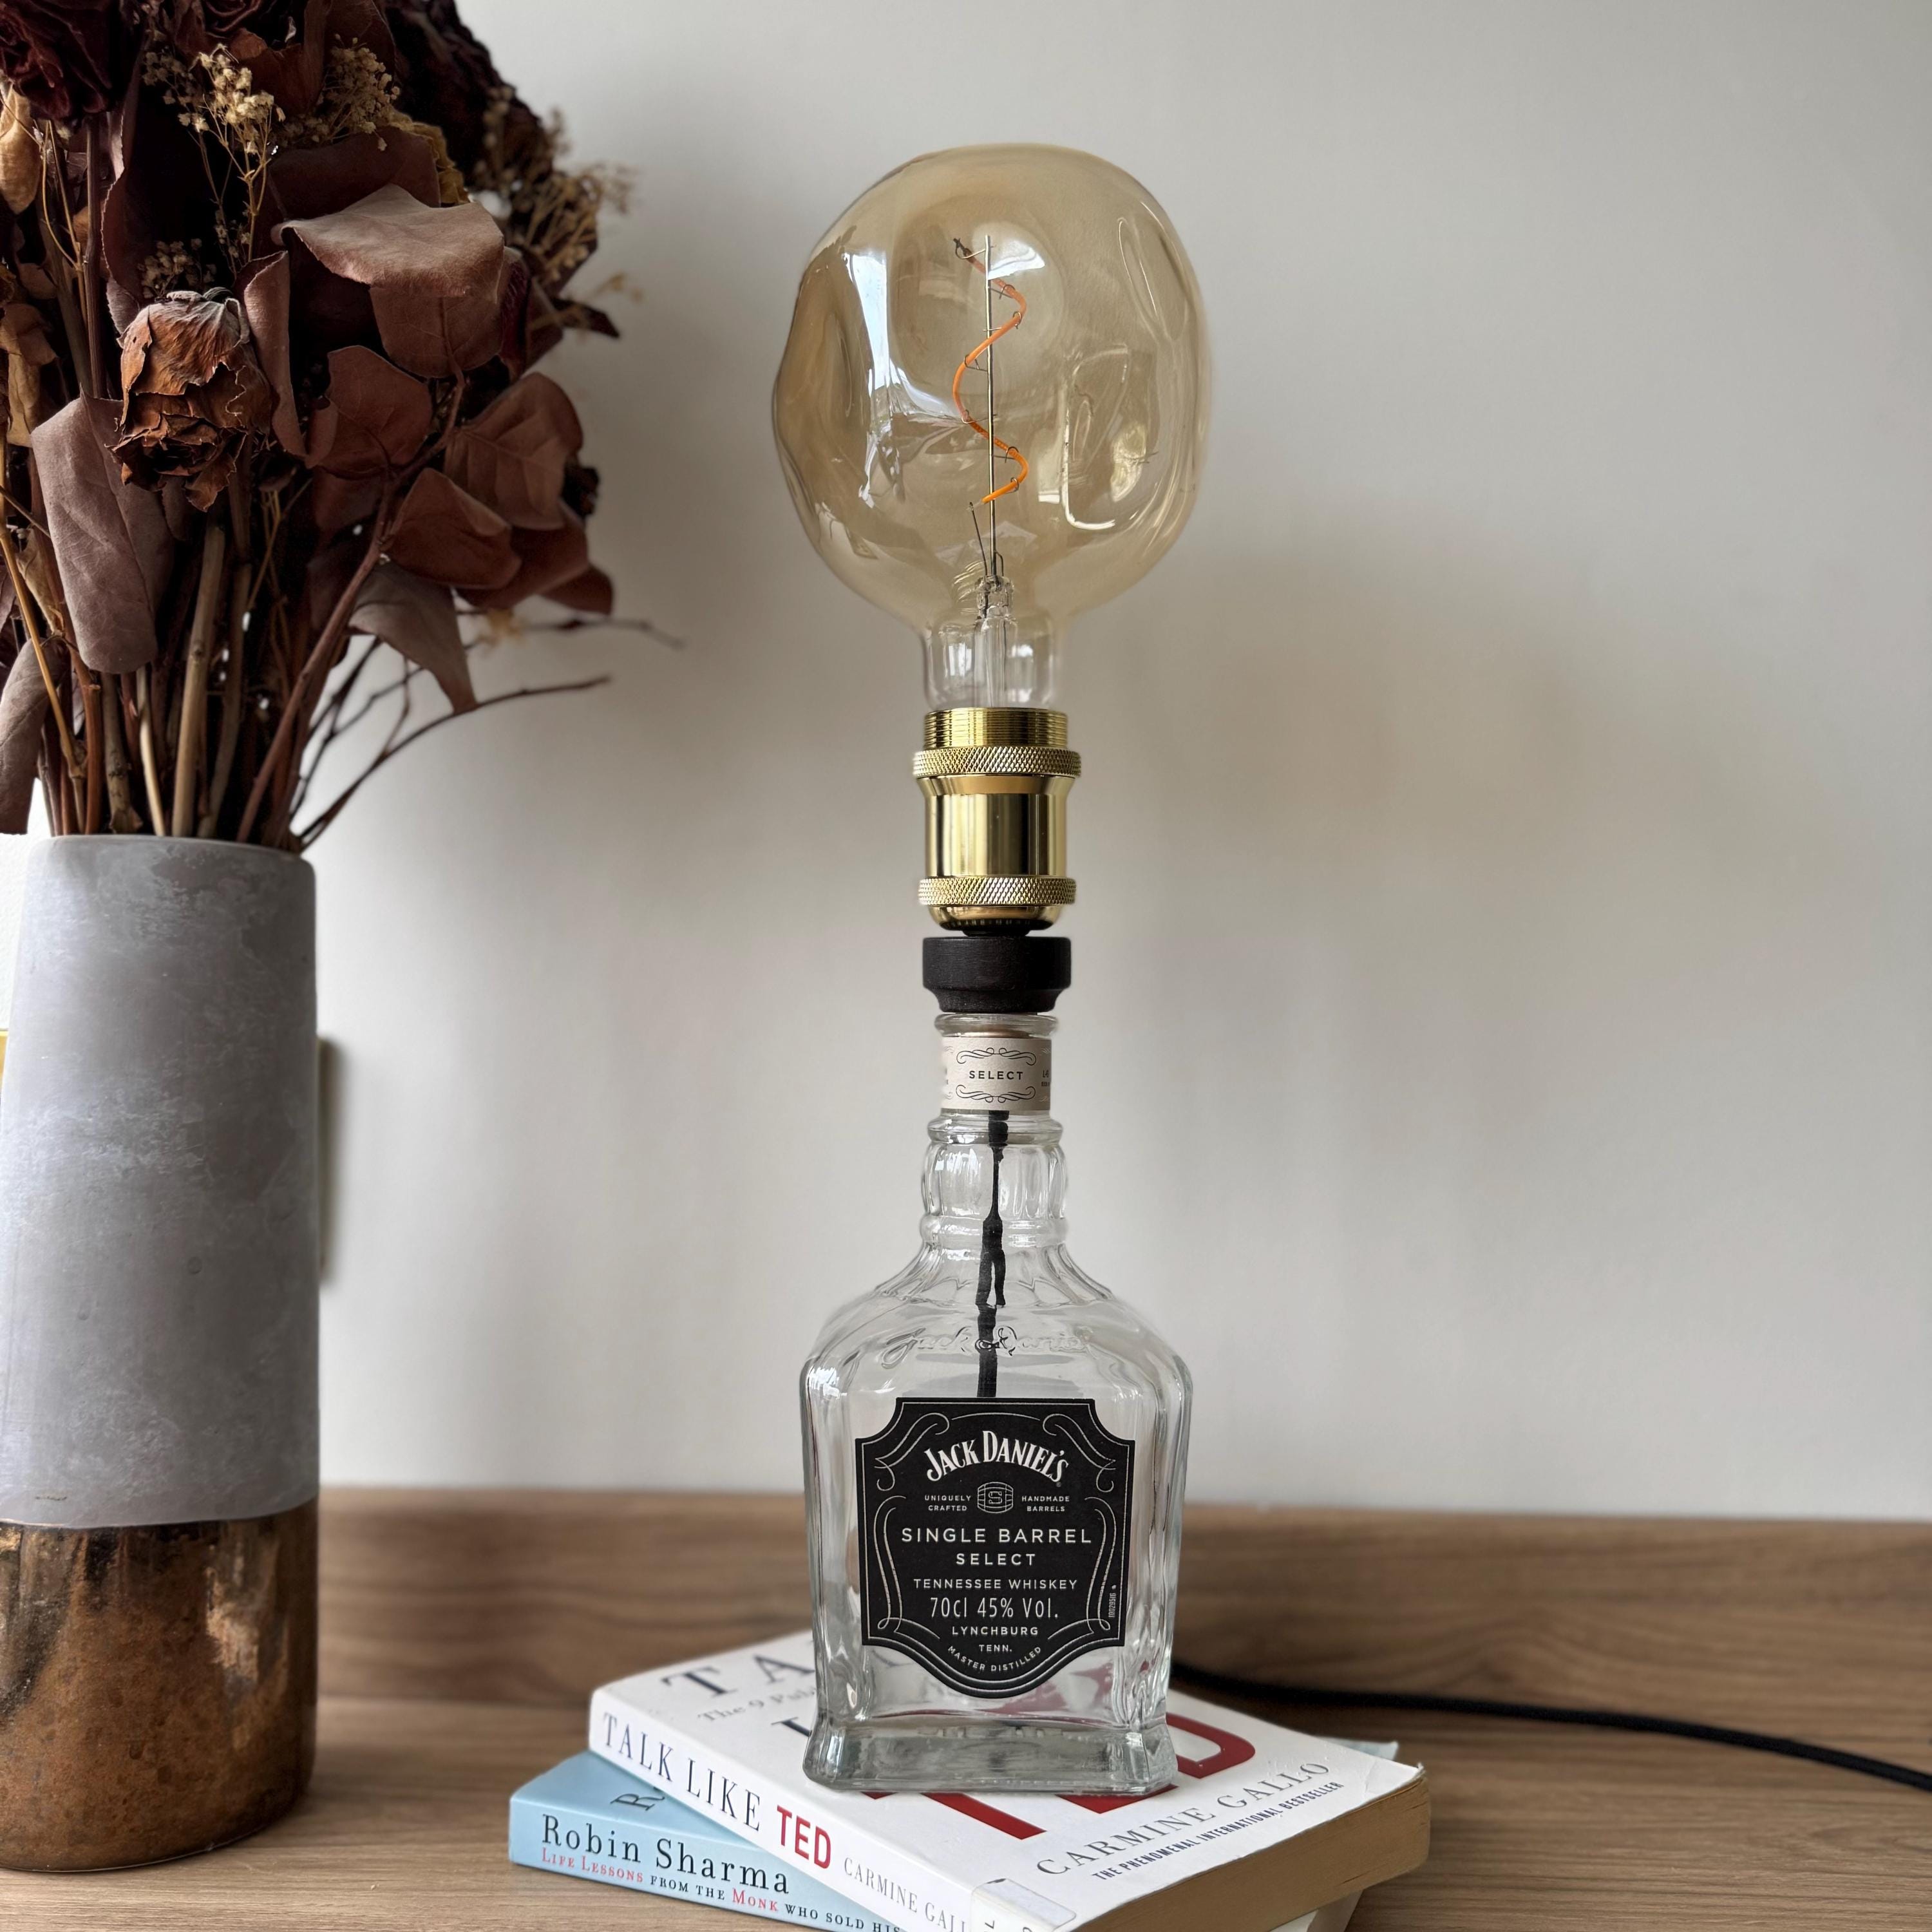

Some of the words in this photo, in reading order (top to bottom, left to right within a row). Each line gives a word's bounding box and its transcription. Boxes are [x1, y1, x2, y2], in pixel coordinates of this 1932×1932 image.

[969, 1070, 1023, 1080] SELECT
[923, 1438, 980, 1481] JACK
[982, 1430, 1070, 1482] DANIEL'S
[901, 1527, 986, 1543] SINGLE
[999, 1528, 1092, 1544] BARREL
[956, 1553, 1036, 1566] SELECT
[913, 1578, 1001, 1589] TENNESSEE
[1009, 1579, 1078, 1590] WHISKEY
[930, 1597, 967, 1618] 70cl
[977, 1597, 1014, 1618] 45%
[1023, 1598, 1059, 1618] Vol.
[952, 1626, 1039, 1636] LYNCHBURG
[947, 1645, 986, 1671] MASTER
[990, 1646, 1041, 1672] DISTILLED
[978, 1644, 1012, 1653] TENN.
[603, 1712, 674, 1783] TALK
[687, 1757, 761, 1832] LIKE
[777, 1804, 831, 1869] TED
[844, 1857, 918, 1913] CARMINE
[1036, 1807, 1217, 1875] CARMINE
[1217, 1763, 1329, 1808] GALLO
[1092, 1863, 1122, 1880] THE
[1119, 1838, 1201, 1870] PHENOMENAL
[1196, 1807, 1283, 1841] INTERNATIONAL
[1279, 1781, 1345, 1810] BESTSELLER
[542, 1814, 641, 1863] Robin
[656, 1838, 790, 1895] Sharma
[649, 1875, 689, 1893] FROM
[696, 1885, 726, 1900] THE
[785, 1904, 819, 1920] WHO
[826, 1913, 864, 1930] SOLD
